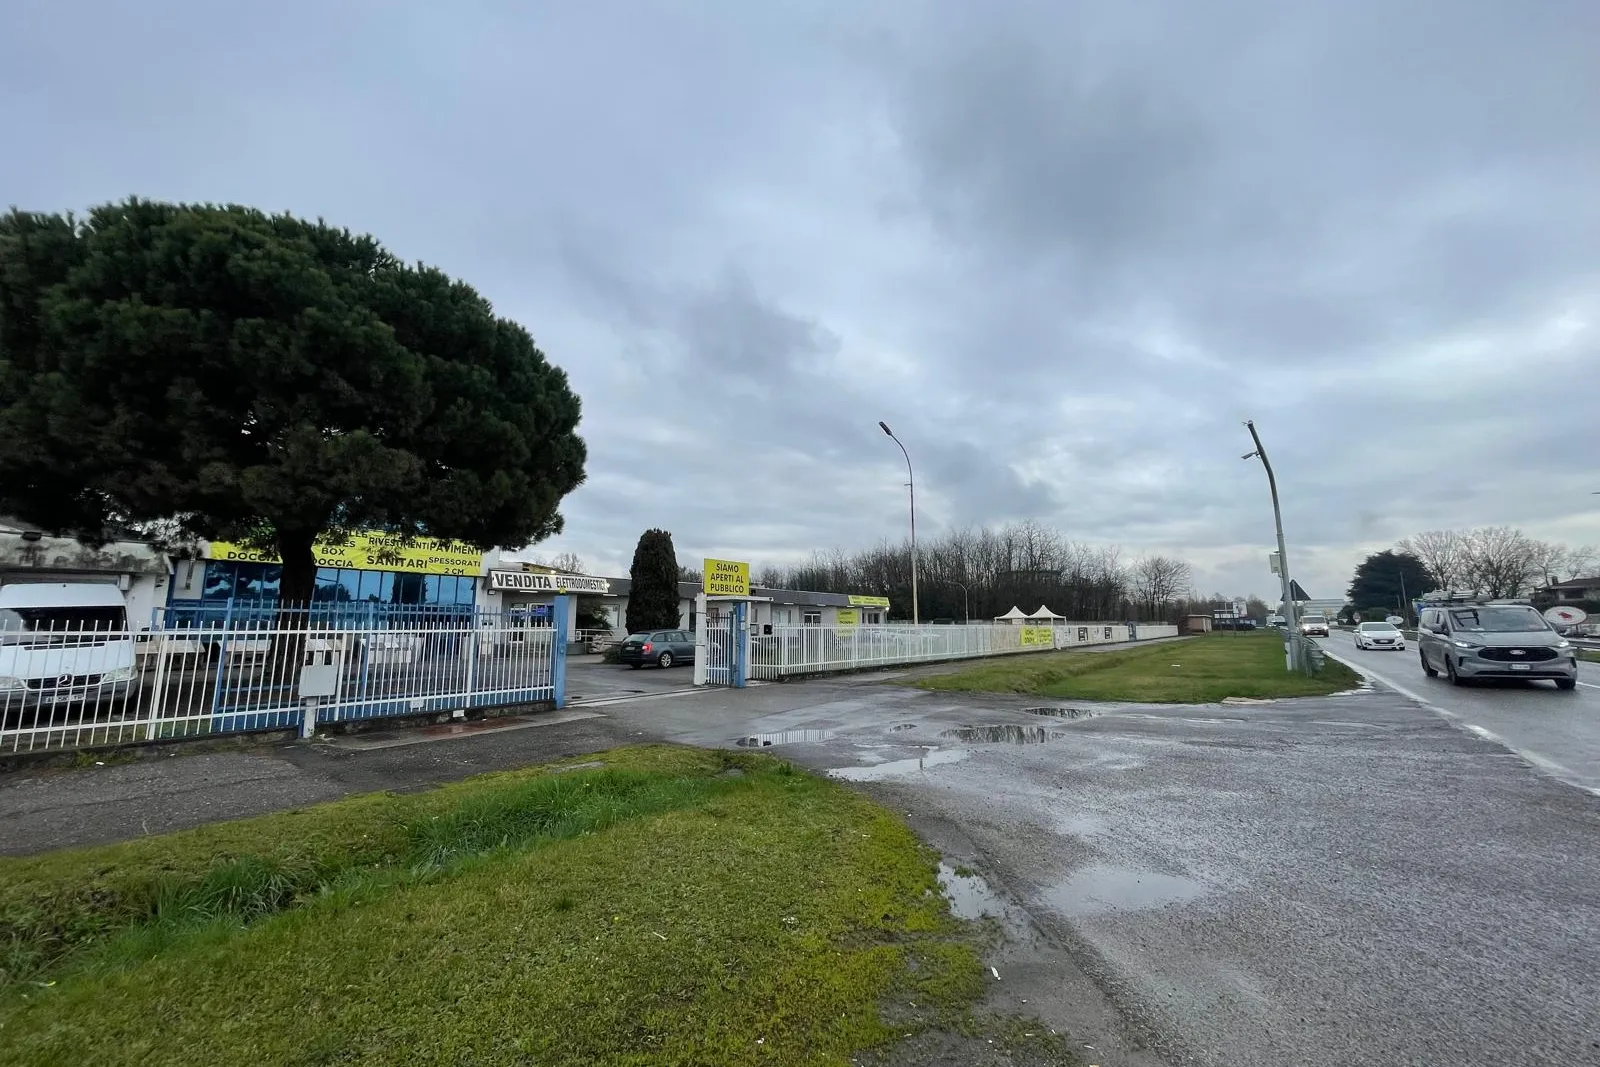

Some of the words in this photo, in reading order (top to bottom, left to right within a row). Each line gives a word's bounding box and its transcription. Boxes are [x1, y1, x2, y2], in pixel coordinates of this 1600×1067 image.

[321, 547, 345, 556] BOX
[366, 555, 428, 569] SANITARI
[716, 563, 739, 573] SIAMO
[495, 573, 552, 589] VENDITA
[711, 573, 734, 583] APERTI
[736, 575, 744, 583] AL
[711, 583, 744, 593] PUBBLICO
